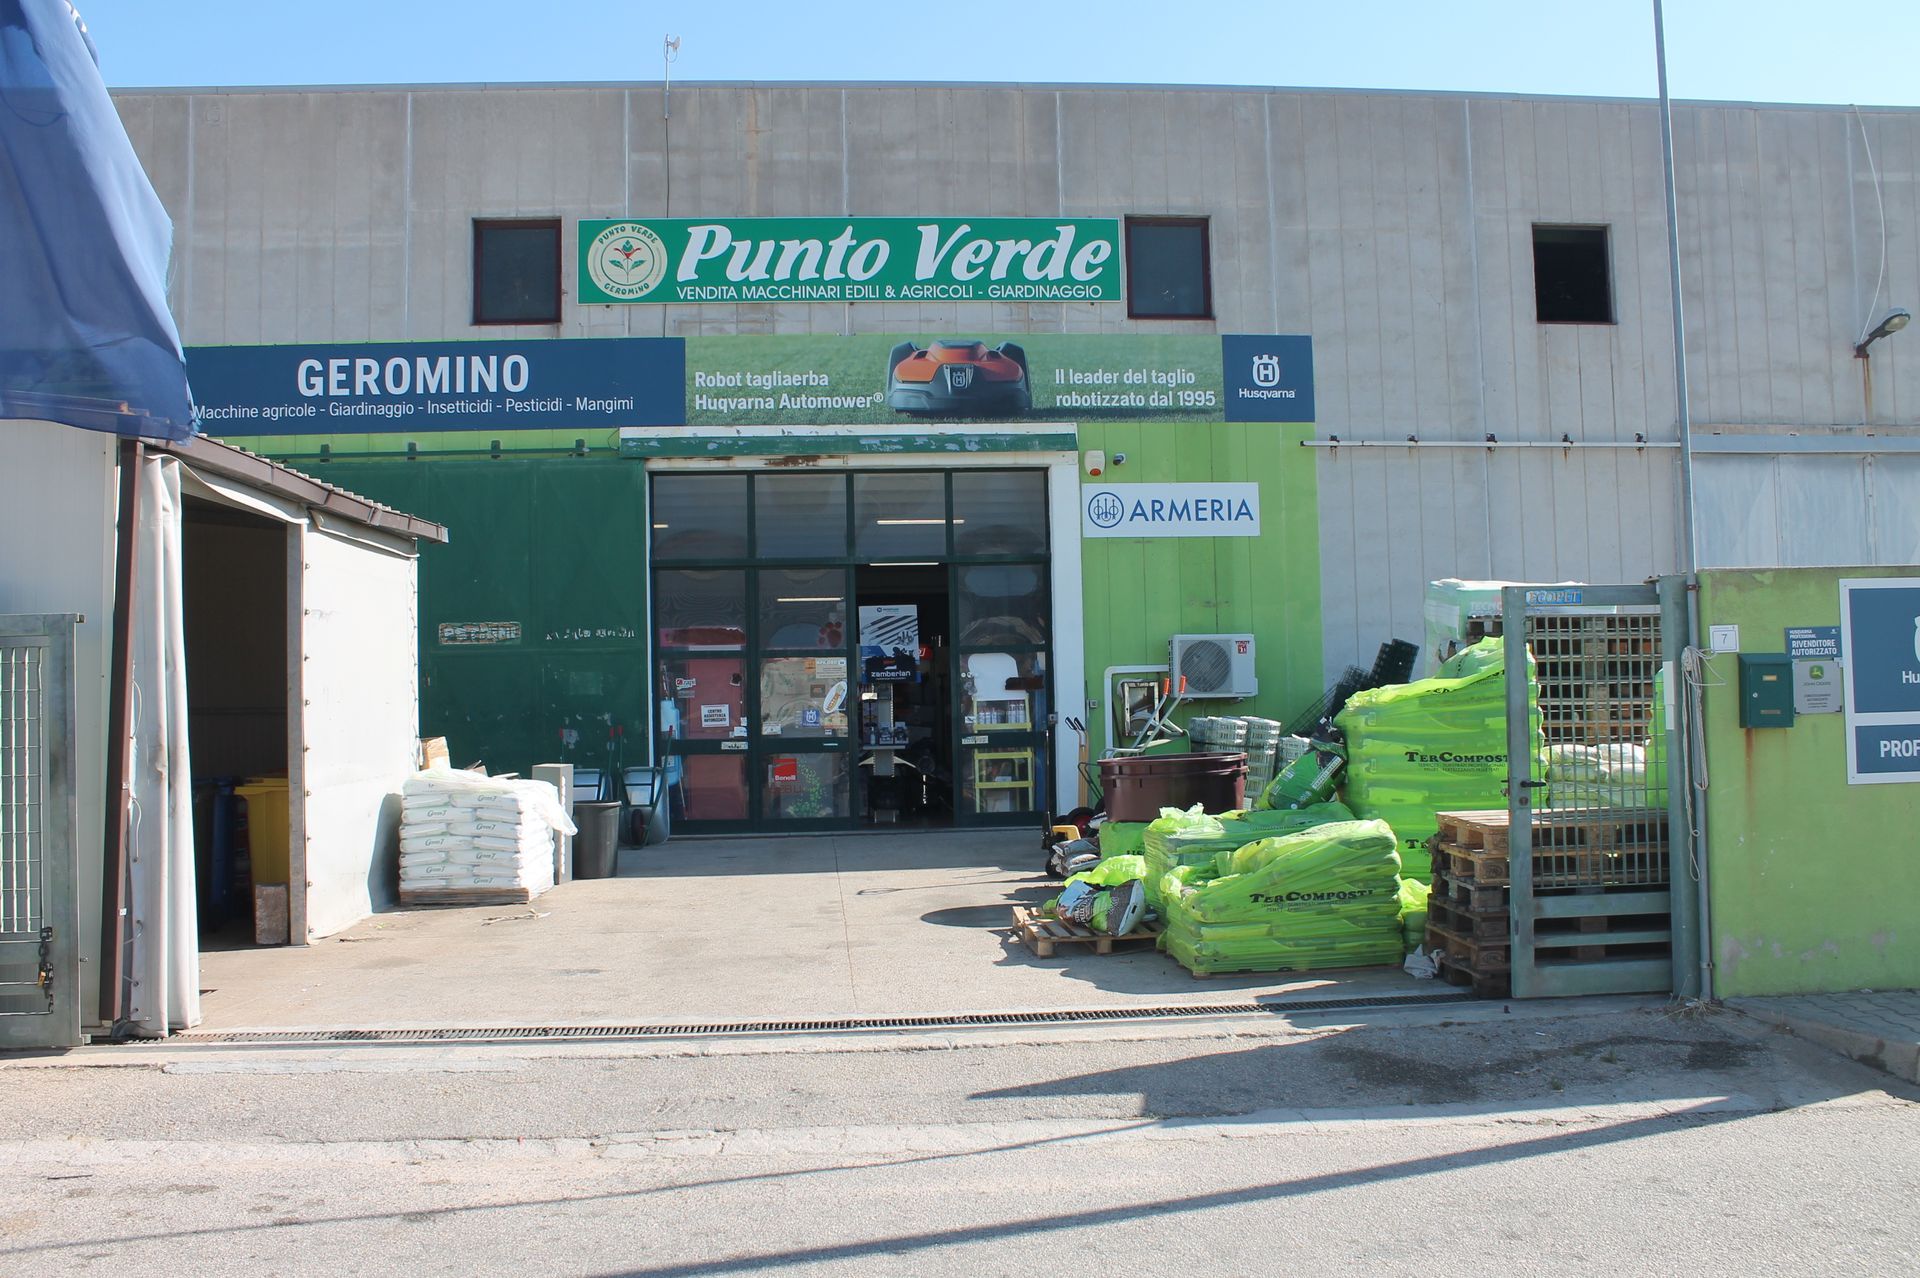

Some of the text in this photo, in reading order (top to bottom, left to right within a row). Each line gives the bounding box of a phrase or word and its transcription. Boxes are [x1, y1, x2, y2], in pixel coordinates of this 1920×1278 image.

[598, 226, 658, 245] PUNTO VERDE
[676, 224, 1112, 282] Punto Verde
[604, 282, 650, 296] GEROMINO
[676, 286, 738, 300] VENDITA
[742, 286, 840, 299] MACCHINARI
[846, 286, 879, 299] EDILI
[885, 285, 897, 298] &
[900, 285, 973, 298] AGRICOLI
[987, 285, 1103, 298] GIARDINAGGIO
[297, 354, 530, 397] GEROMINO
[695, 370, 829, 390] Robot tagliaerba
[1055, 368, 1196, 388] Il leader del taglio
[695, 394, 775, 413] Huqvarna
[1056, 390, 1216, 407] robotizzato dal 1995
[1239, 388, 1296, 400] Husqvarna
[193, 404, 259, 420] Macchine
[262, 403, 316, 421] agricole
[329, 401, 414, 418] Giardinaggio
[427, 399, 493, 415] Insetticidi
[505, 397, 563, 413] Pesticidi
[576, 396, 634, 414] Mangimi
[1129, 498, 1254, 522] ARMERIA
[1721, 633, 1728, 645] 7
[1791, 639, 1836, 649] RIVENDITORE
[1791, 647, 1837, 657] AUTORIZZATO
[1902, 670, 1920, 684] Hu
[1879, 739, 1920, 758] PROF
